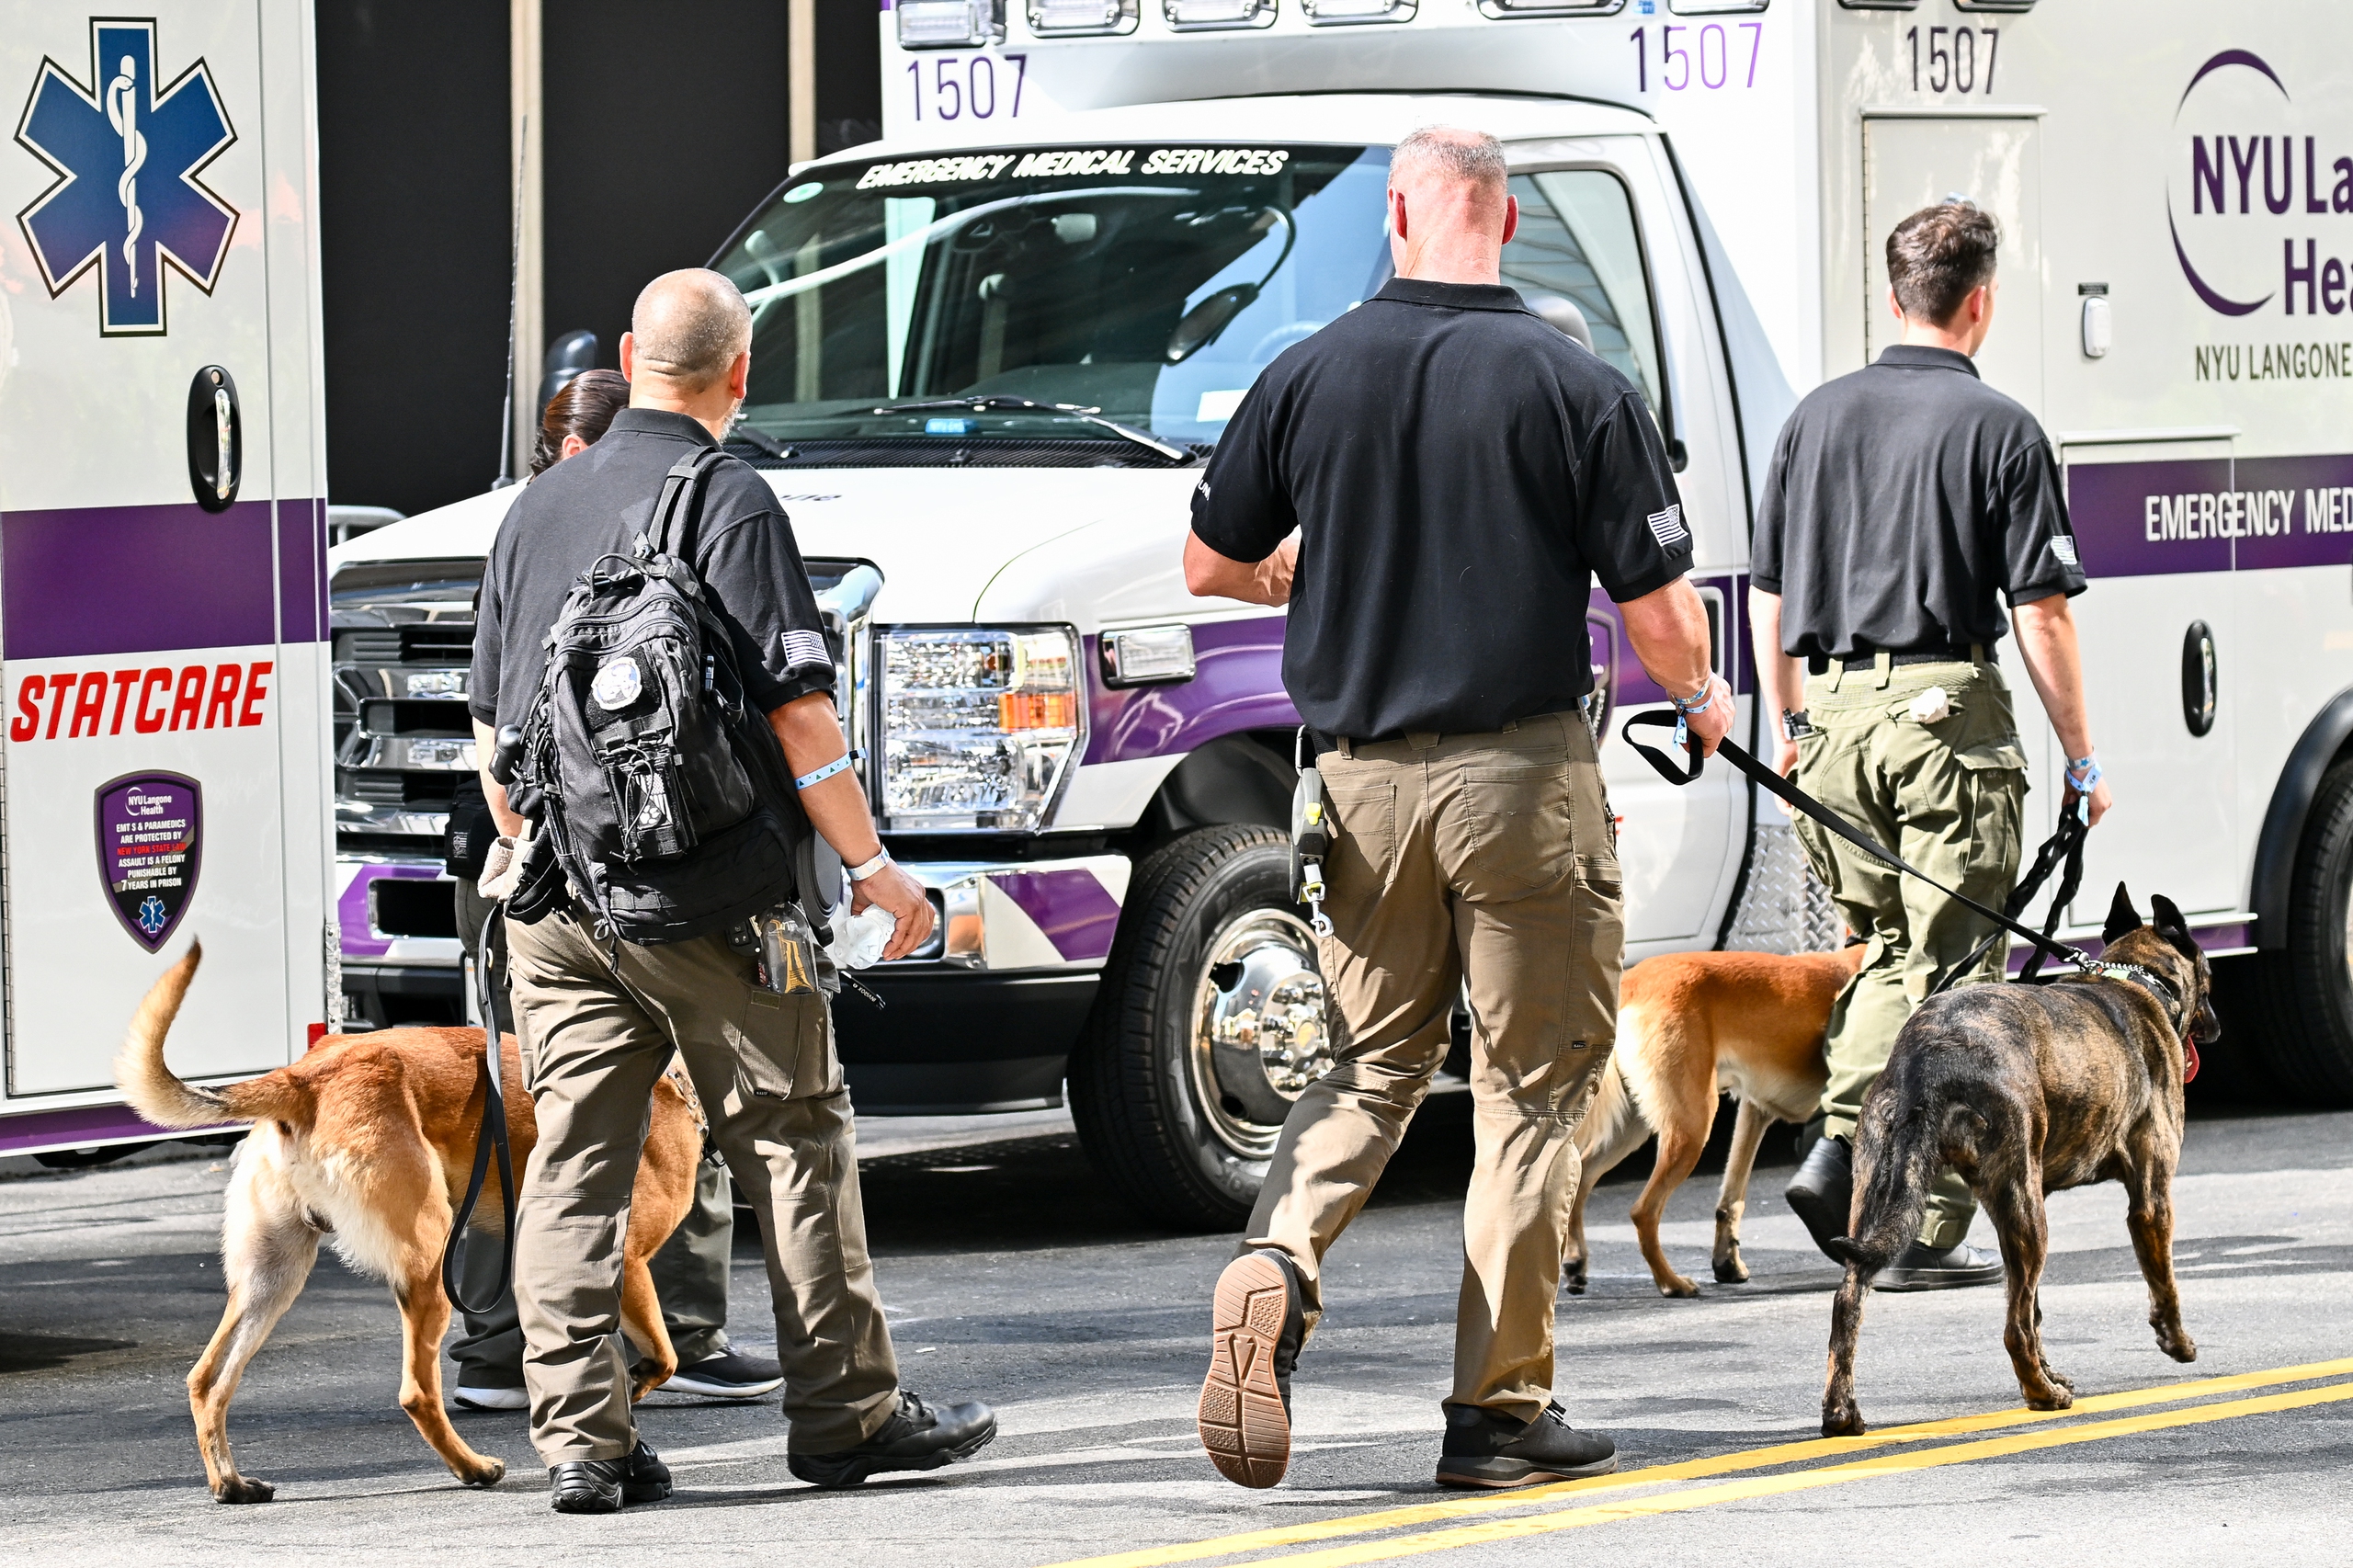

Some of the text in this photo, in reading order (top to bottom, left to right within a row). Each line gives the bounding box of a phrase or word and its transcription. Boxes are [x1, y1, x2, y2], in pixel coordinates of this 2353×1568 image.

[1630, 22, 1762, 93] 1507
[1906, 25, 2000, 95] 1507
[907, 53, 1028, 121] 1507
[856, 148, 1290, 189] EMERGENCY MEDICAL SERVICES
[2192, 135, 2292, 215] NYU
[2284, 238, 2353, 315] He
[2195, 342, 2352, 381] NYU LANGONE
[2145, 489, 2295, 541] EMERGENCY
[10, 661, 273, 743] STATCARE
[128, 795, 172, 806] NYU Langone
[140, 805, 164, 815] Health
[120, 831, 182, 844] ARE PROTECTED BY
[137, 822, 143, 831] &
[144, 819, 186, 831] PARAMEDICS
[117, 842, 187, 856] NEW YORK STATE LAW
[119, 854, 186, 868] ASSAULT IS A FELONY
[120, 877, 182, 892] 7 YEARS IN PRISON
[127, 866, 177, 879] PUNISHABLE BY
